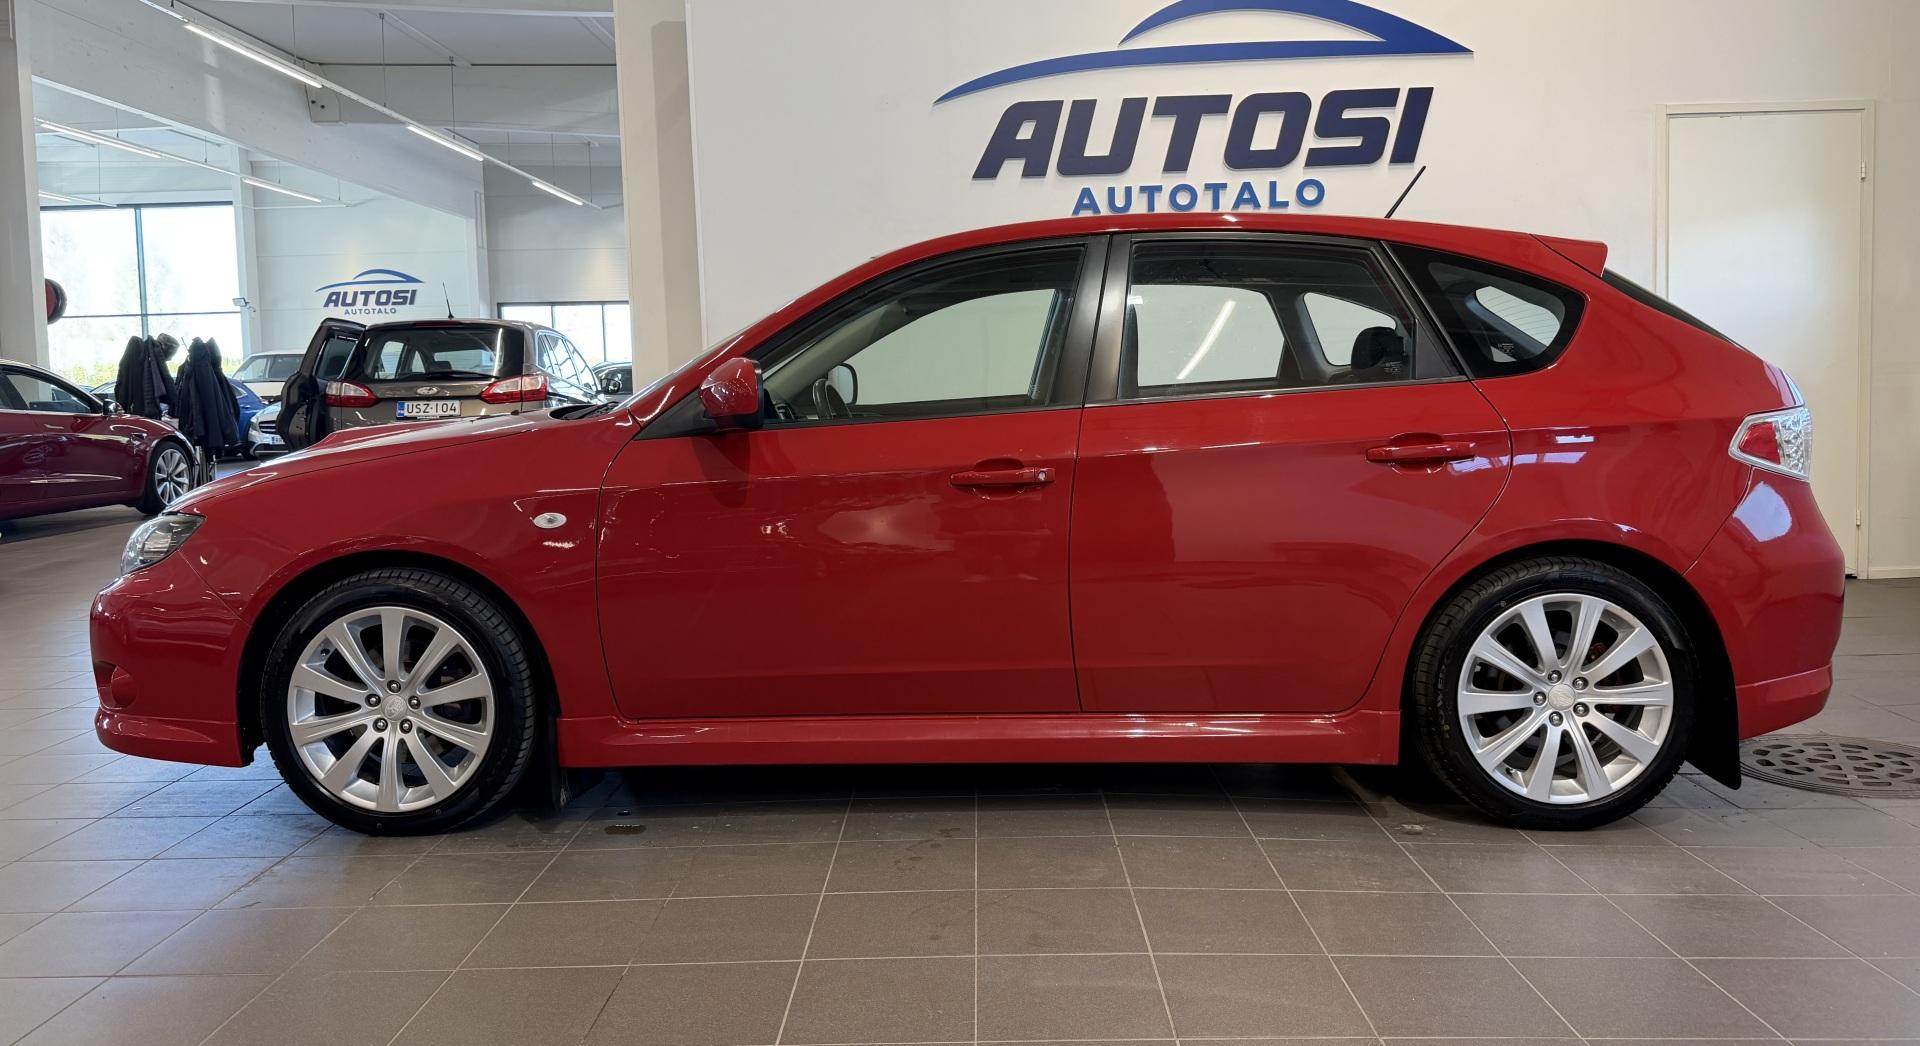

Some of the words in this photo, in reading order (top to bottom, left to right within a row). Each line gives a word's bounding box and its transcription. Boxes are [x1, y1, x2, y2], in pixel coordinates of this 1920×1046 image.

[972, 87, 1434, 179] AUTOSI
[1071, 178, 1326, 216] AUTOTALO
[323, 289, 418, 308] AUTOSI
[343, 307, 397, 316] AUTOTALO
[406, 402, 457, 414] USZ-104
